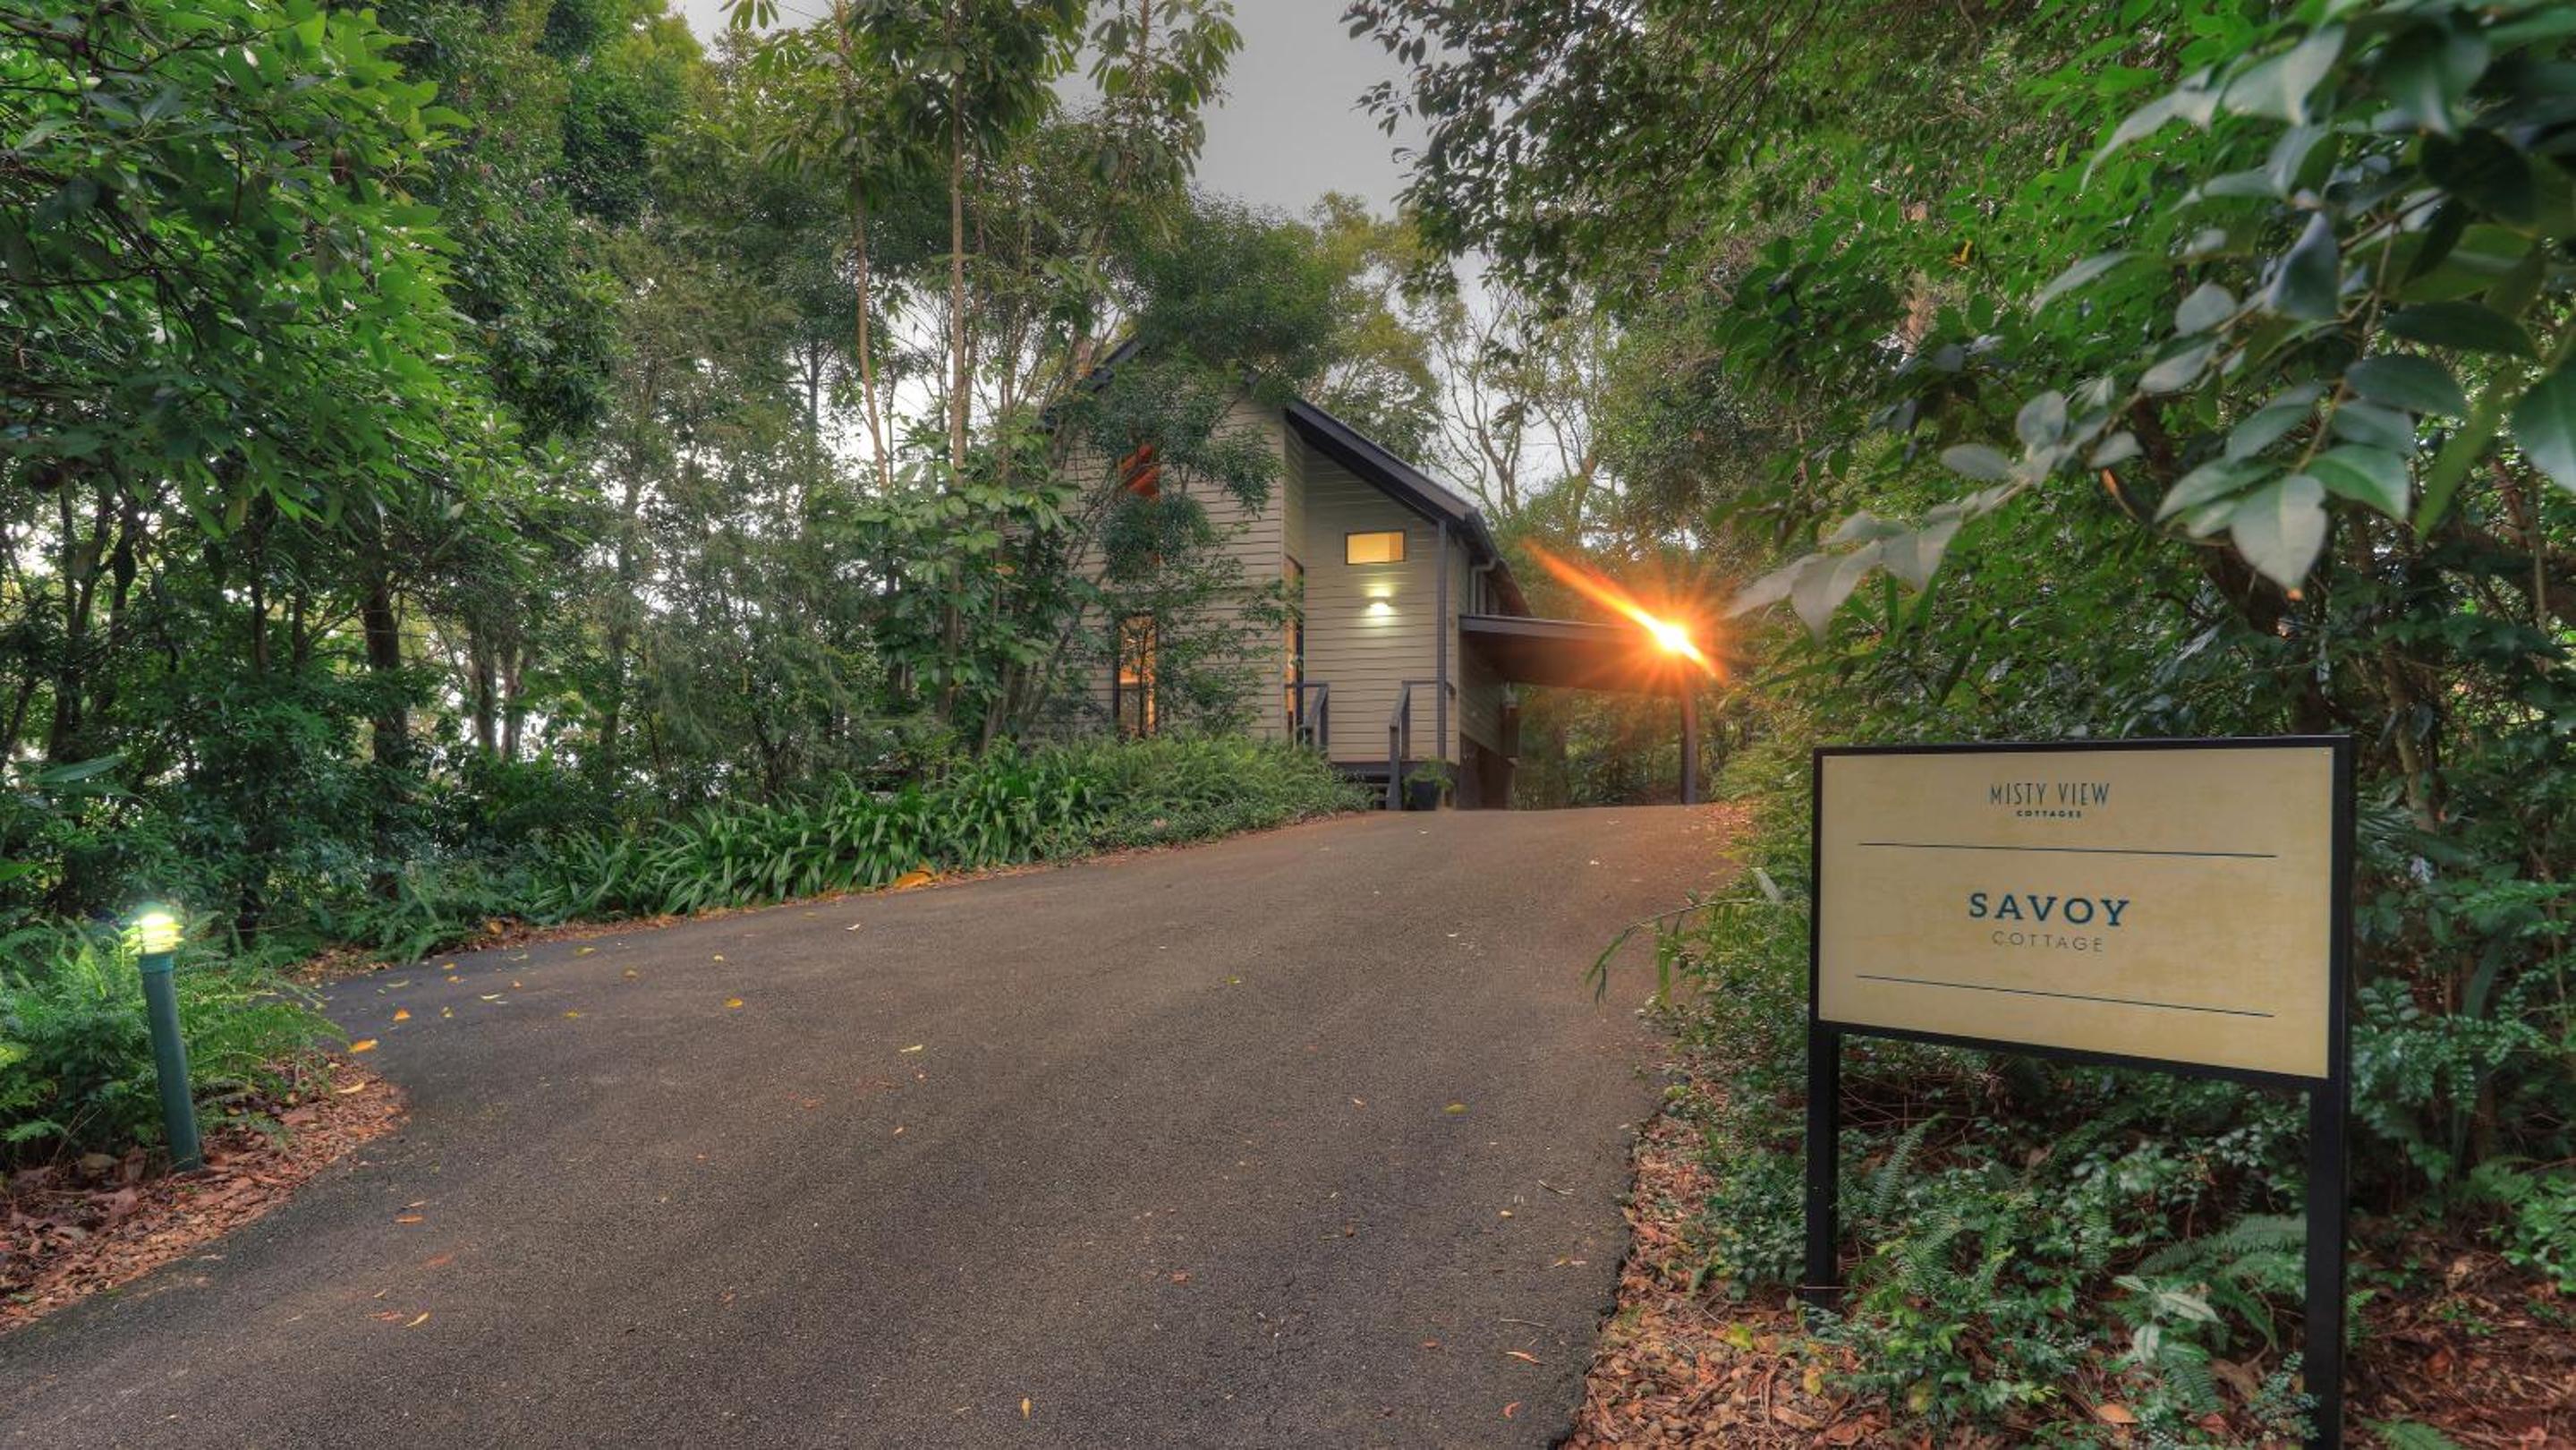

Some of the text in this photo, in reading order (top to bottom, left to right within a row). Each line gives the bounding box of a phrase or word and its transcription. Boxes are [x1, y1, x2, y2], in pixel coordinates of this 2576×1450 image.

[1989, 781, 2111, 806] MISTY VIEW
[2016, 809, 2082, 819] COTTAGES
[1968, 892, 2130, 927] SAVOY
[1992, 930, 2104, 953] COTTAGE
